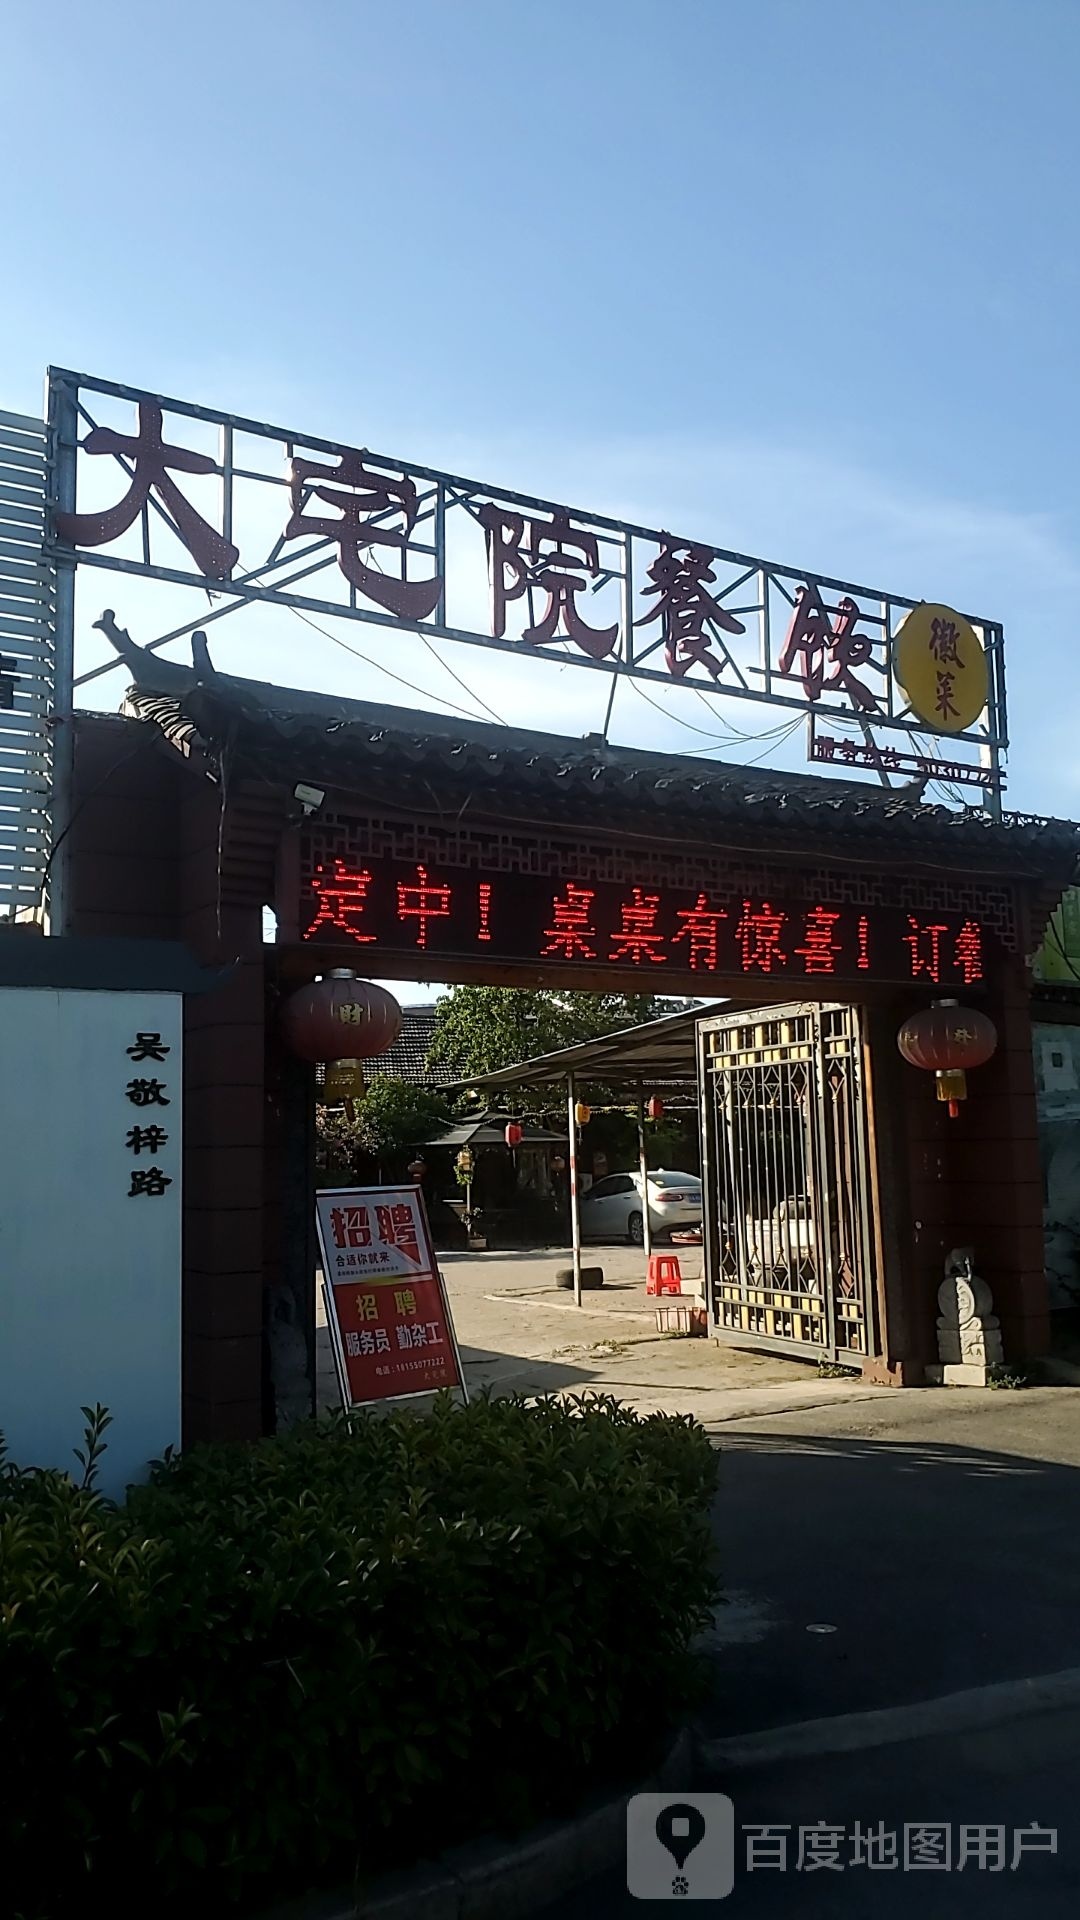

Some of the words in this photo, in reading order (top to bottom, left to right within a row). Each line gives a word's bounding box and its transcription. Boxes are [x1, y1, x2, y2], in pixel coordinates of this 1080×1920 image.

[929, 617, 965, 721] 徽菜
[125, 1033, 172, 1197] 吴敬梓路
[330, 1203, 419, 1249] 招聘
[356, 1289, 418, 1322] 招聘
